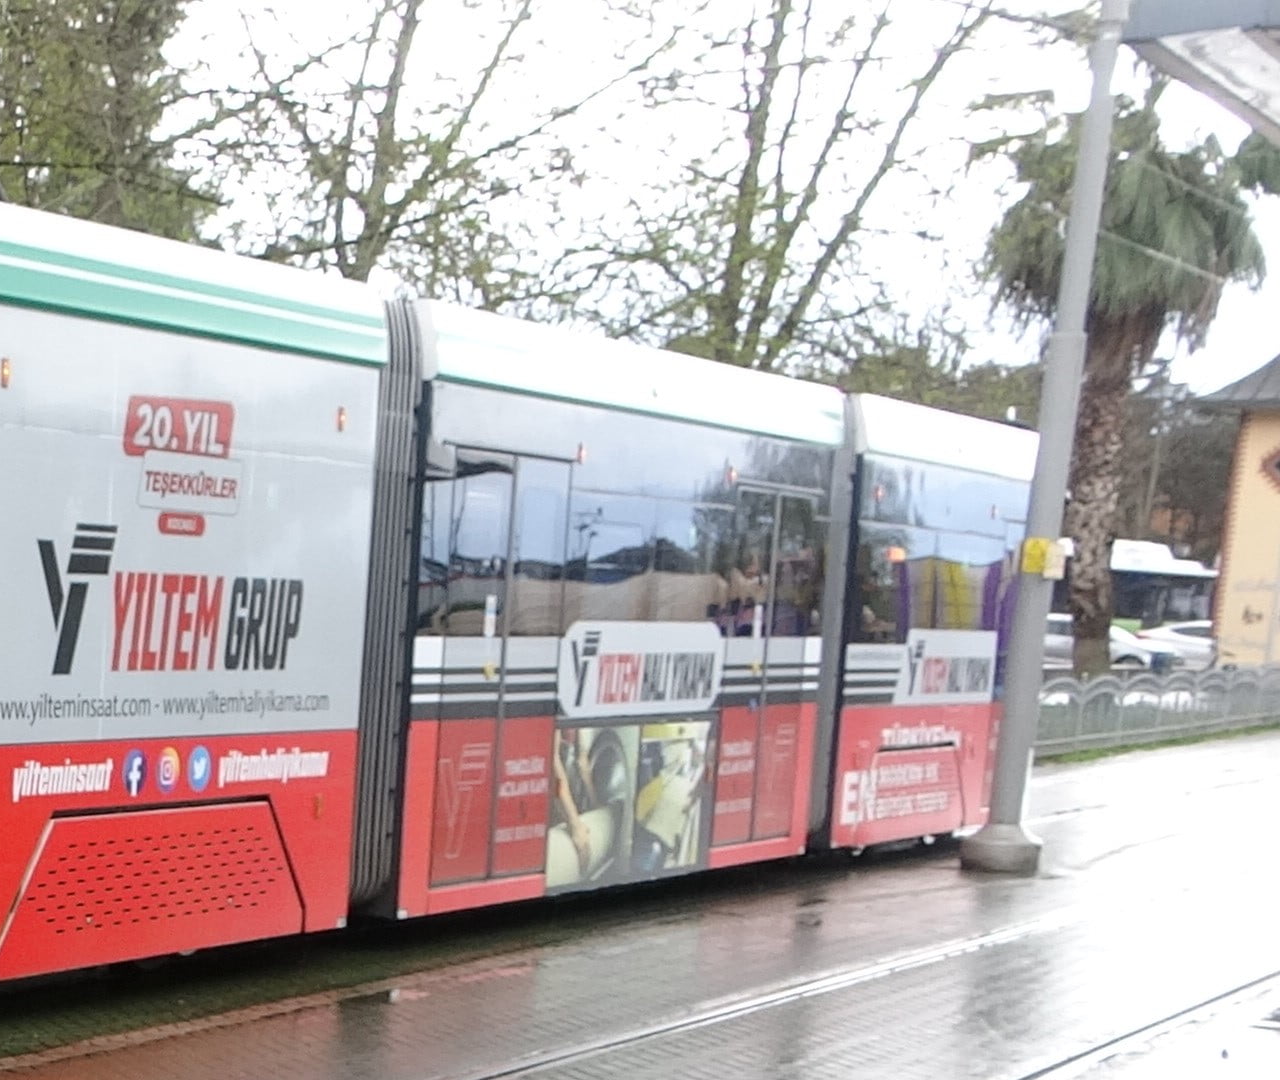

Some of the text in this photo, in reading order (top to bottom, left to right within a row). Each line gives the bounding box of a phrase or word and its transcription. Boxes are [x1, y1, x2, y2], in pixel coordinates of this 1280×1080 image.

[132, 402, 225, 455] 20. YIL
[145, 469, 238, 500] TEŞEKKÜRLER
[111, 570, 304, 672] YILTEM GRUP
[11, 757, 114, 803] yilteminsaat
